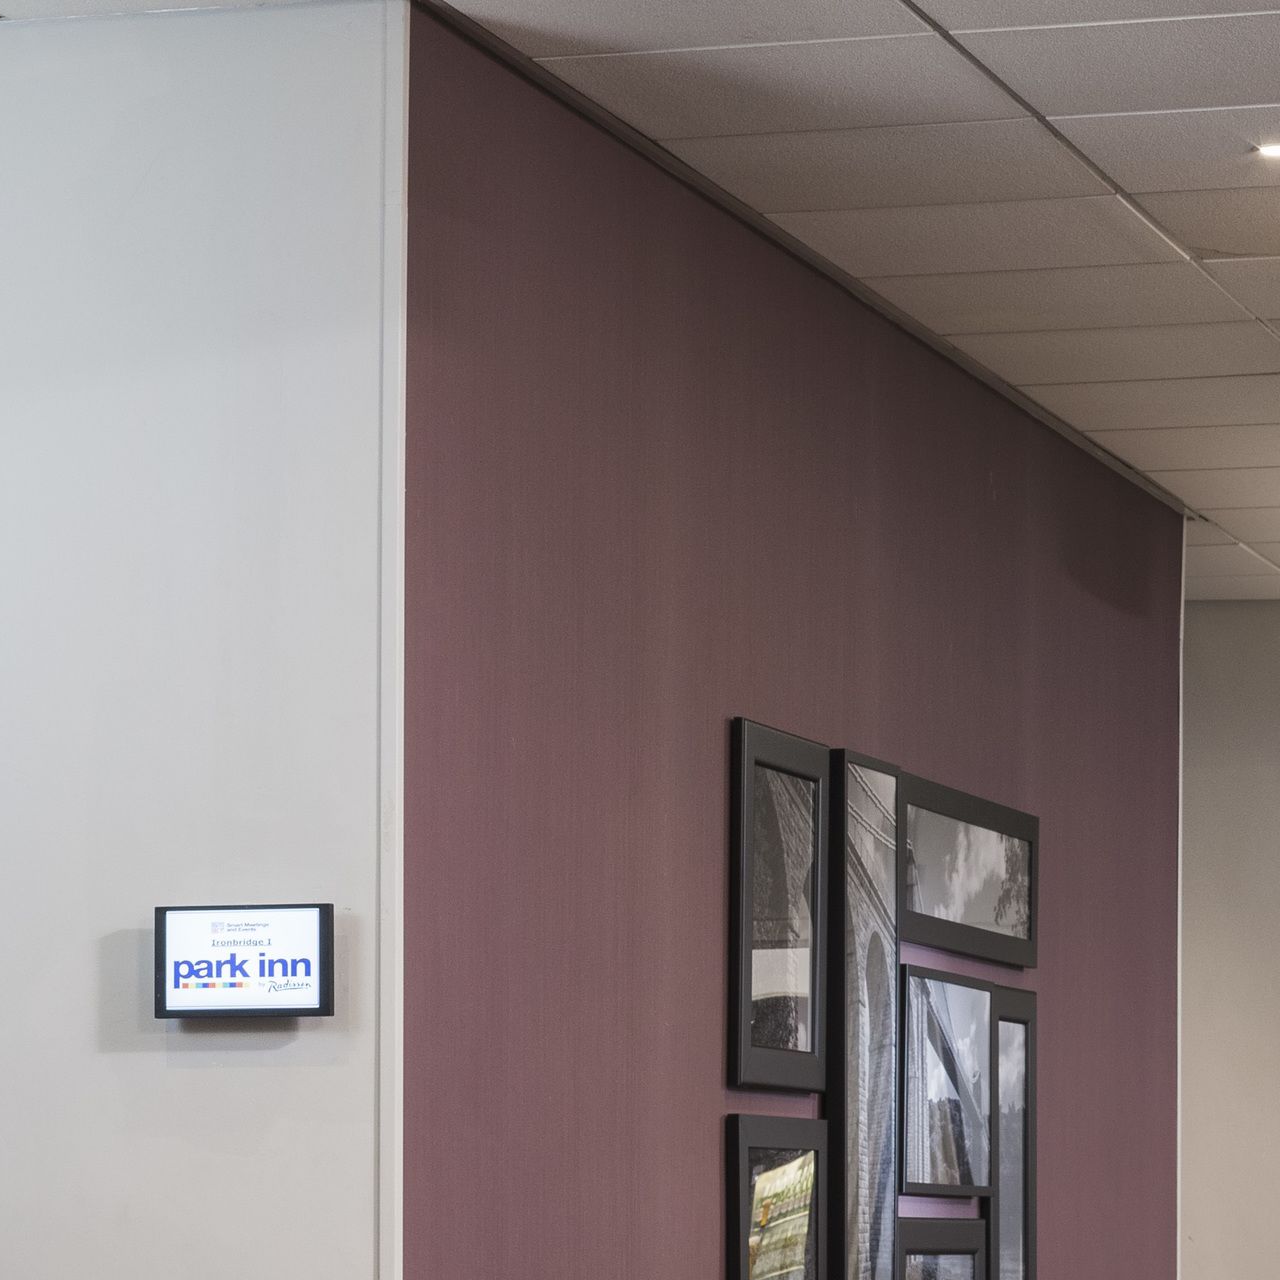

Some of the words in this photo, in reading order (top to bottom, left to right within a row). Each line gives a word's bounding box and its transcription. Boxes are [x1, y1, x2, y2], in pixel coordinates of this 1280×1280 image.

[211, 938, 264, 947] Ironbridge
[173, 952, 250, 989] park
[259, 952, 311, 977] inn
[267, 979, 312, 993] Radisson
